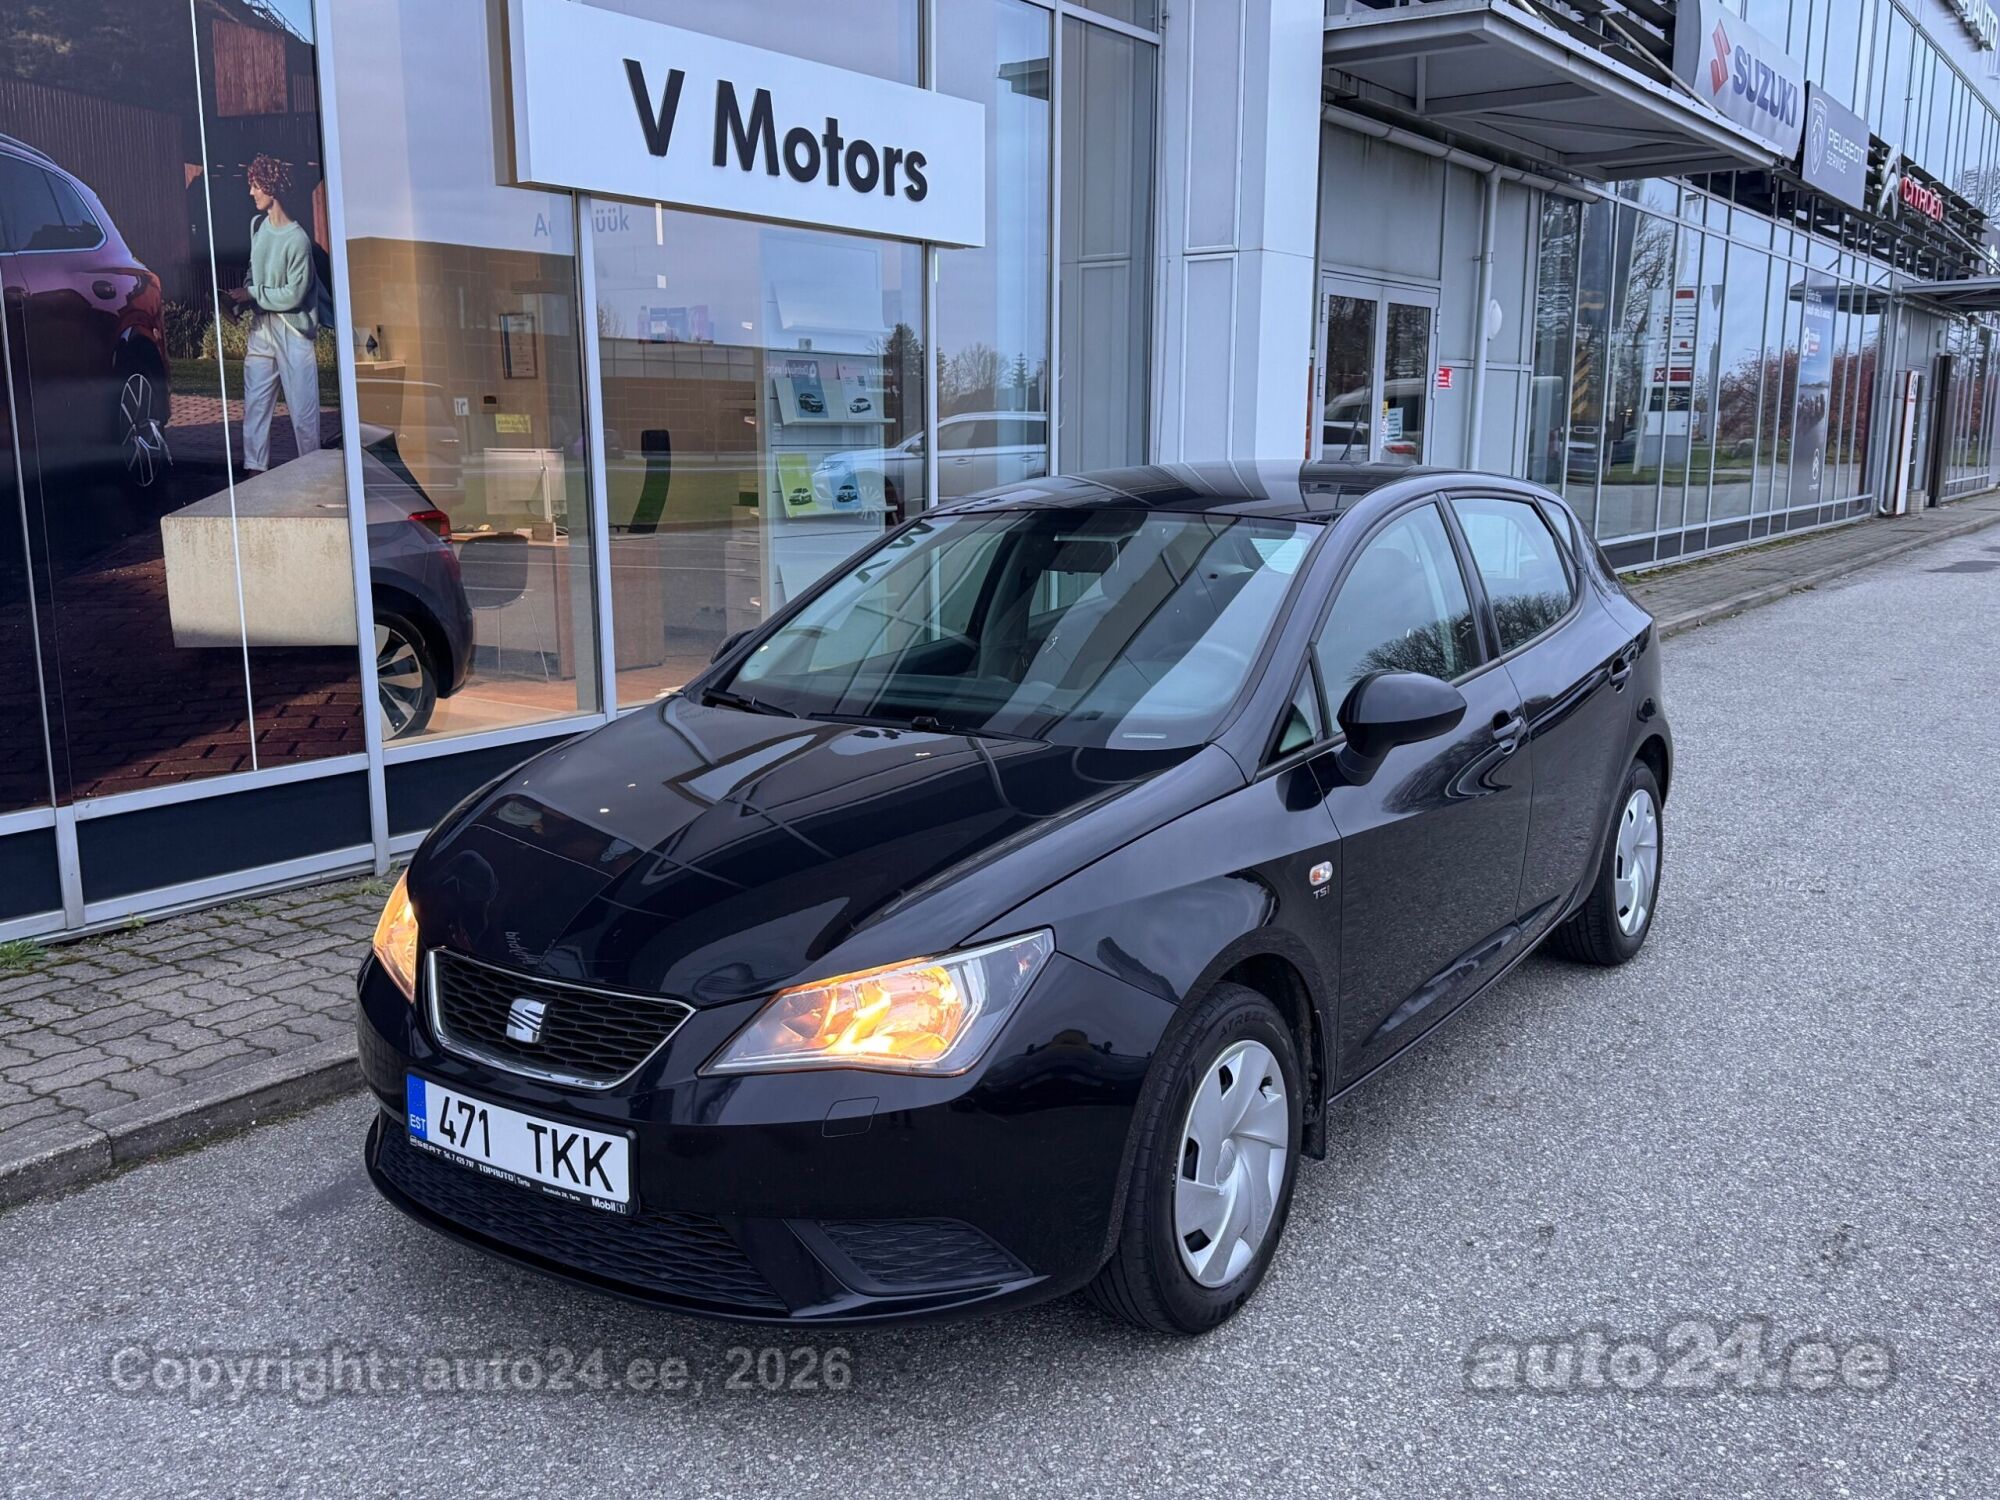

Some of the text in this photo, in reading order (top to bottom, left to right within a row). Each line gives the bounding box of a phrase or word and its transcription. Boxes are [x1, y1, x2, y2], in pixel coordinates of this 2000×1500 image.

[1733, 45, 1797, 128] SUZUKI
[622, 58, 928, 202] V Motors
[1828, 128, 1865, 166] PEUGEOT
[1826, 150, 1847, 174] SERVICE
[1313, 885, 1330, 899] TSI
[410, 1113, 427, 1131] EST
[416, 1140, 442, 1155] SEAT
[478, 1163, 514, 1182] TOPAUTO
[439, 1096, 615, 1193] 471 TKK
[591, 1197, 616, 1212] Mobil
